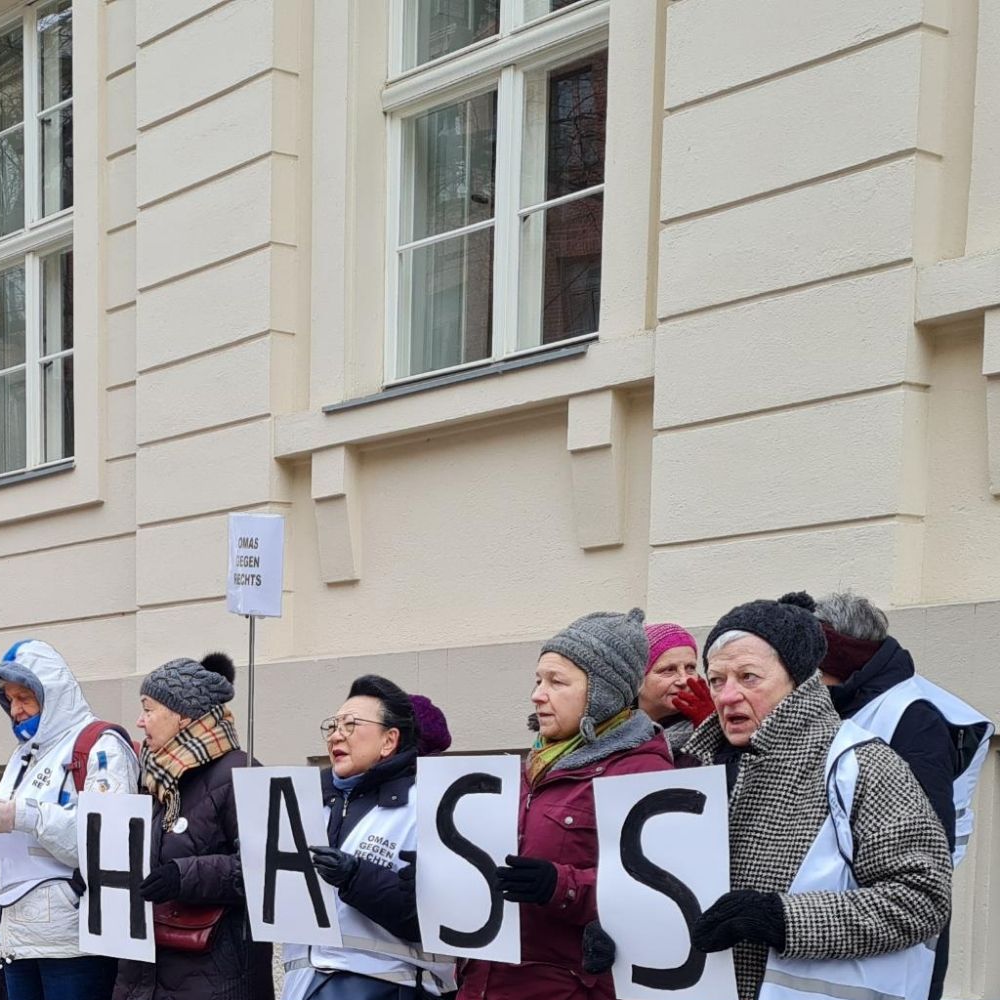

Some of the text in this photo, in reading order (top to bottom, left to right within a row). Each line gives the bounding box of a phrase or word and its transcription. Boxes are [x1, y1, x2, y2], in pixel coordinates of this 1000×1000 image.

[237, 536, 260, 550] OMAS
[235, 555, 260, 568] GEGEN
[233, 572, 262, 587] RECHTS
[359, 841, 395, 860] GEGEN
[367, 834, 398, 850] OMAS
[263, 776, 331, 929] A
[353, 849, 396, 870] RECHTS
[436, 772, 505, 950] S
[86, 812, 147, 940] H
[619, 787, 708, 992] S
